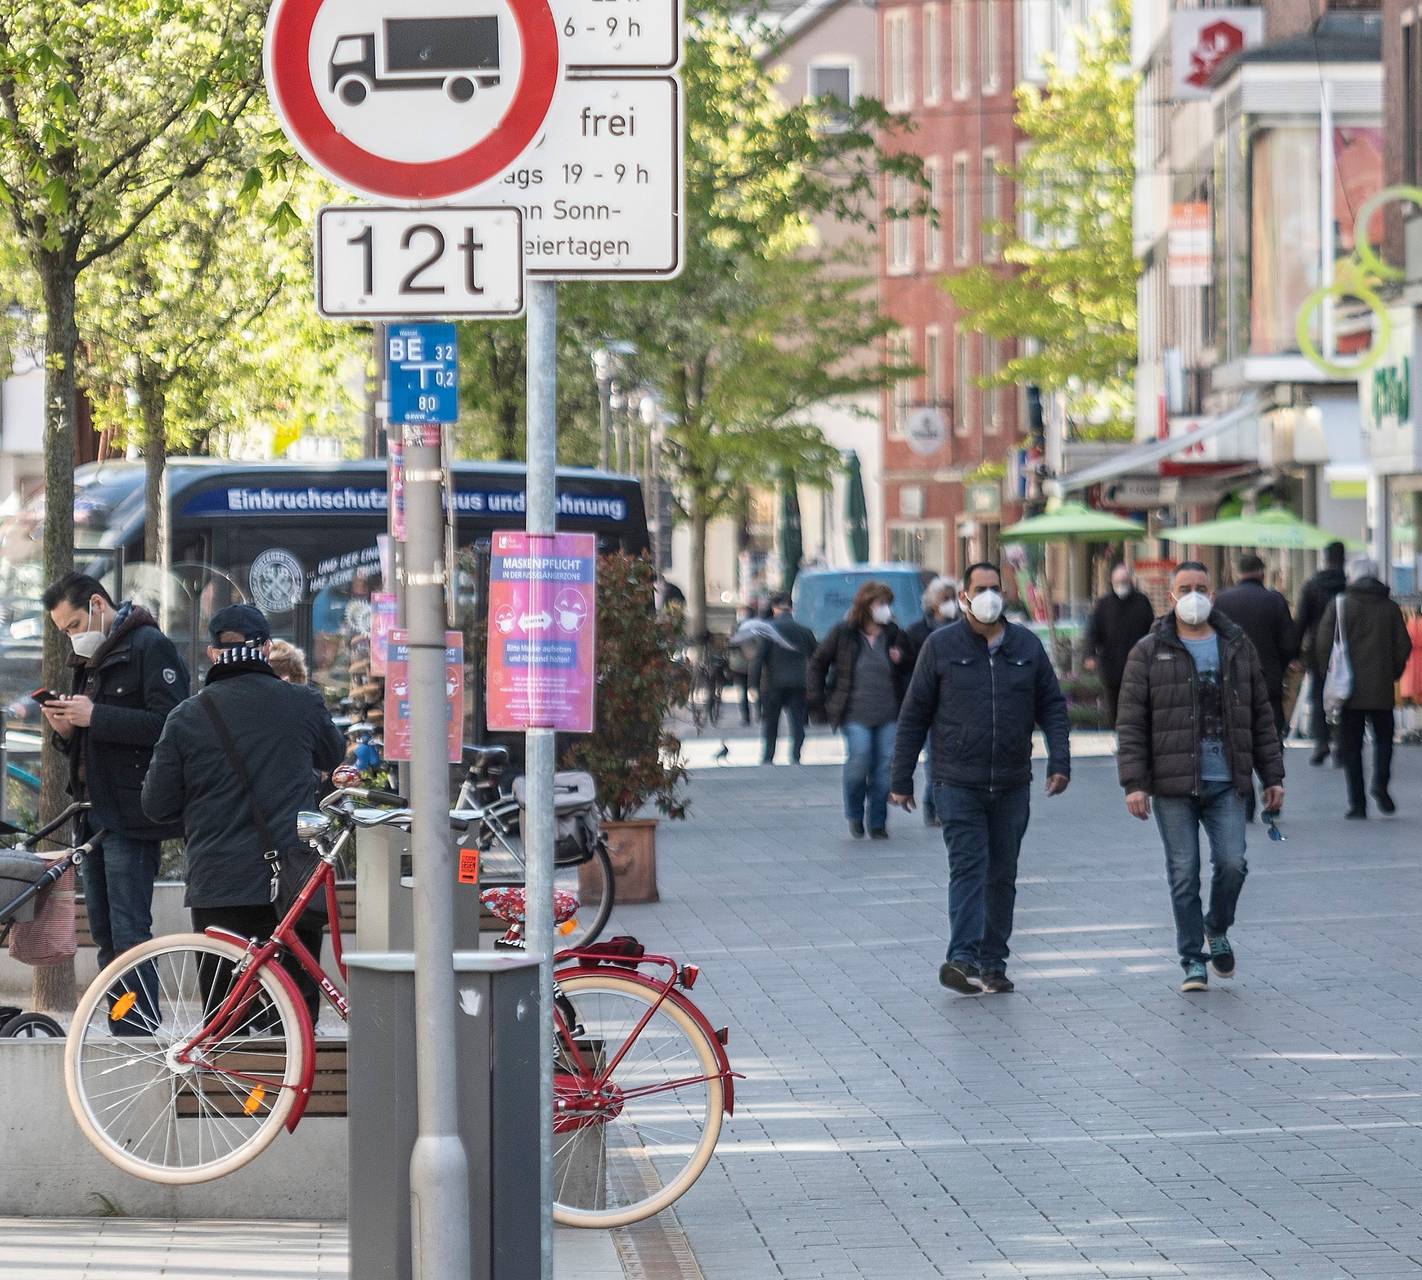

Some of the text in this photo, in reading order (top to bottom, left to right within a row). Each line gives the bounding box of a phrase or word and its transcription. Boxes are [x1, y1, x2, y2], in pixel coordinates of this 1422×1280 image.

[564, 17, 576, 37] 6
[606, 17, 618, 37] 9
[628, 17, 641, 37] h
[580, 107, 635, 137] frei
[499, 168, 543, 190] ags
[561, 164, 583, 184] 19
[614, 164, 626, 184] 9
[636, 164, 649, 184] h
[553, 200, 621, 220] Sonn-
[525, 235, 630, 261] eiertagen
[389, 338, 422, 361] BE
[435, 371, 454, 388] 0,2
[418, 396, 436, 413] 8,0
[228, 487, 388, 511] Einbruchschutz
[488, 493, 527, 512] und
[502, 557, 582, 570] MASKENPFLICHT
[510, 571, 521, 579] DER
